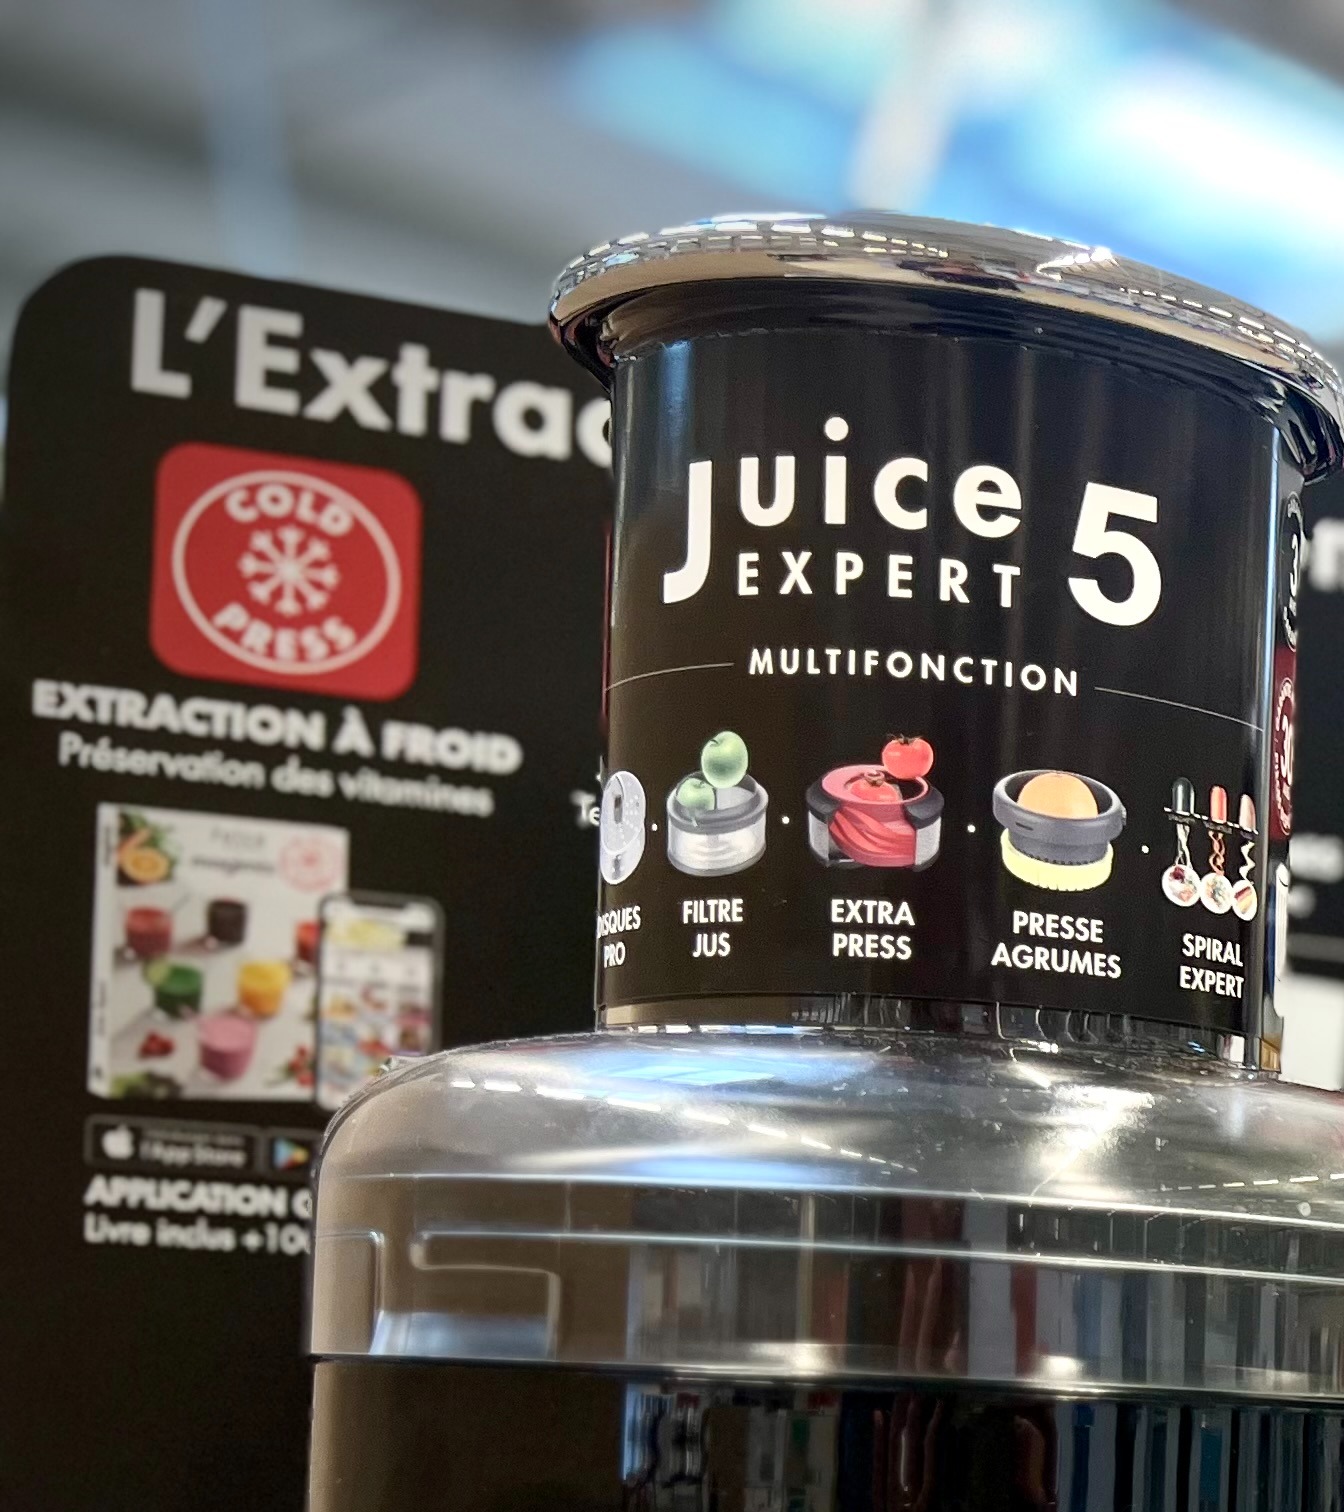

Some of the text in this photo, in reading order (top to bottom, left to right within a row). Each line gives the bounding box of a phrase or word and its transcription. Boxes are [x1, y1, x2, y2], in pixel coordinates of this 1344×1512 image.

[224, 483, 354, 537] COLD
[663, 416, 1023, 604] Juice
[1067, 481, 1162, 626] 5
[737, 552, 1022, 609] EXPERT
[212, 601, 356, 662] PRESS
[748, 647, 1079, 696] MULTIFONCTION
[32, 679, 523, 775] EXTRACTION À FROID
[58, 730, 495, 817] Préservation des vitamines
[596, 905, 641, 938] DISQUES
[682, 898, 744, 924] FILTRE
[831, 898, 915, 926] EXTRA
[1012, 910, 1104, 943] PRESSE
[603, 942, 626, 968] PRO
[692, 932, 731, 958] JUS
[832, 932, 912, 960] PRESS
[991, 942, 1122, 979] AGRUMES
[1182, 932, 1244, 967] SPIRAL
[1179, 965, 1245, 999] EXPERT
[83, 1174, 289, 1219] APPLICATION
[83, 1211, 151, 1246] Livre
[155, 1216, 236, 1250] inclus
